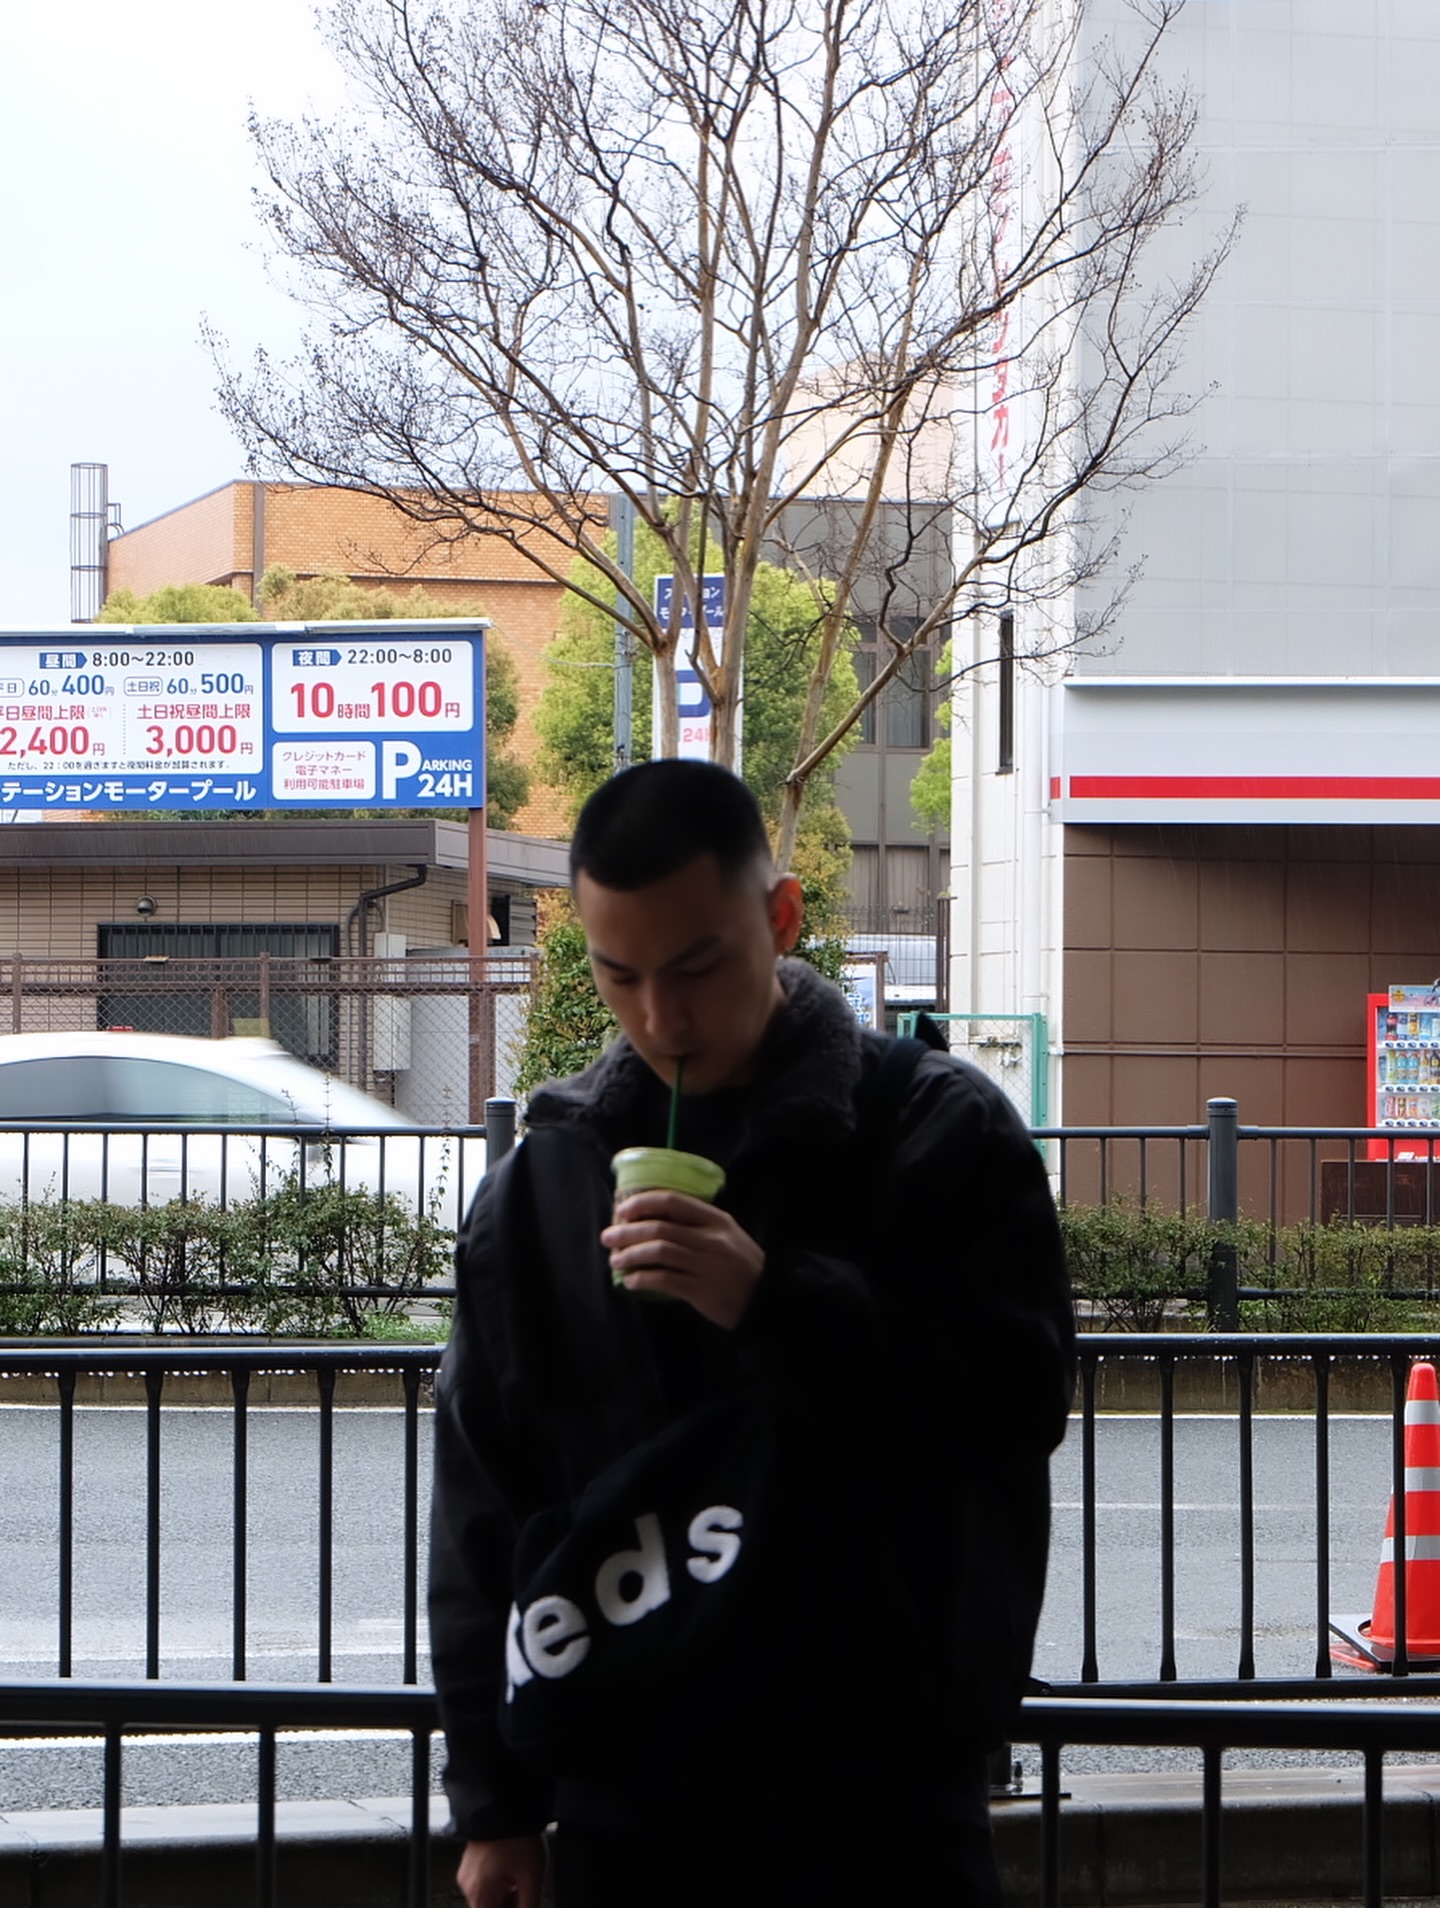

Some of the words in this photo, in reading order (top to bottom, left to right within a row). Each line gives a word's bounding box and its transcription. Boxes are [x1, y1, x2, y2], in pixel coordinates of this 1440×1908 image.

[45, 653, 77, 668] 昼間
[298, 650, 331, 666] 夜間
[127, 681, 160, 693] 土日祝
[137, 703, 251, 720] 土日祝昼間上限
[283, 750, 366, 762] クレジットカード
[295, 765, 353, 776] 電子マネー
[1, 779, 257, 803] テーションモータープール
[284, 778, 365, 791] 利用可能駐車場
[417, 773, 473, 798] 24H
